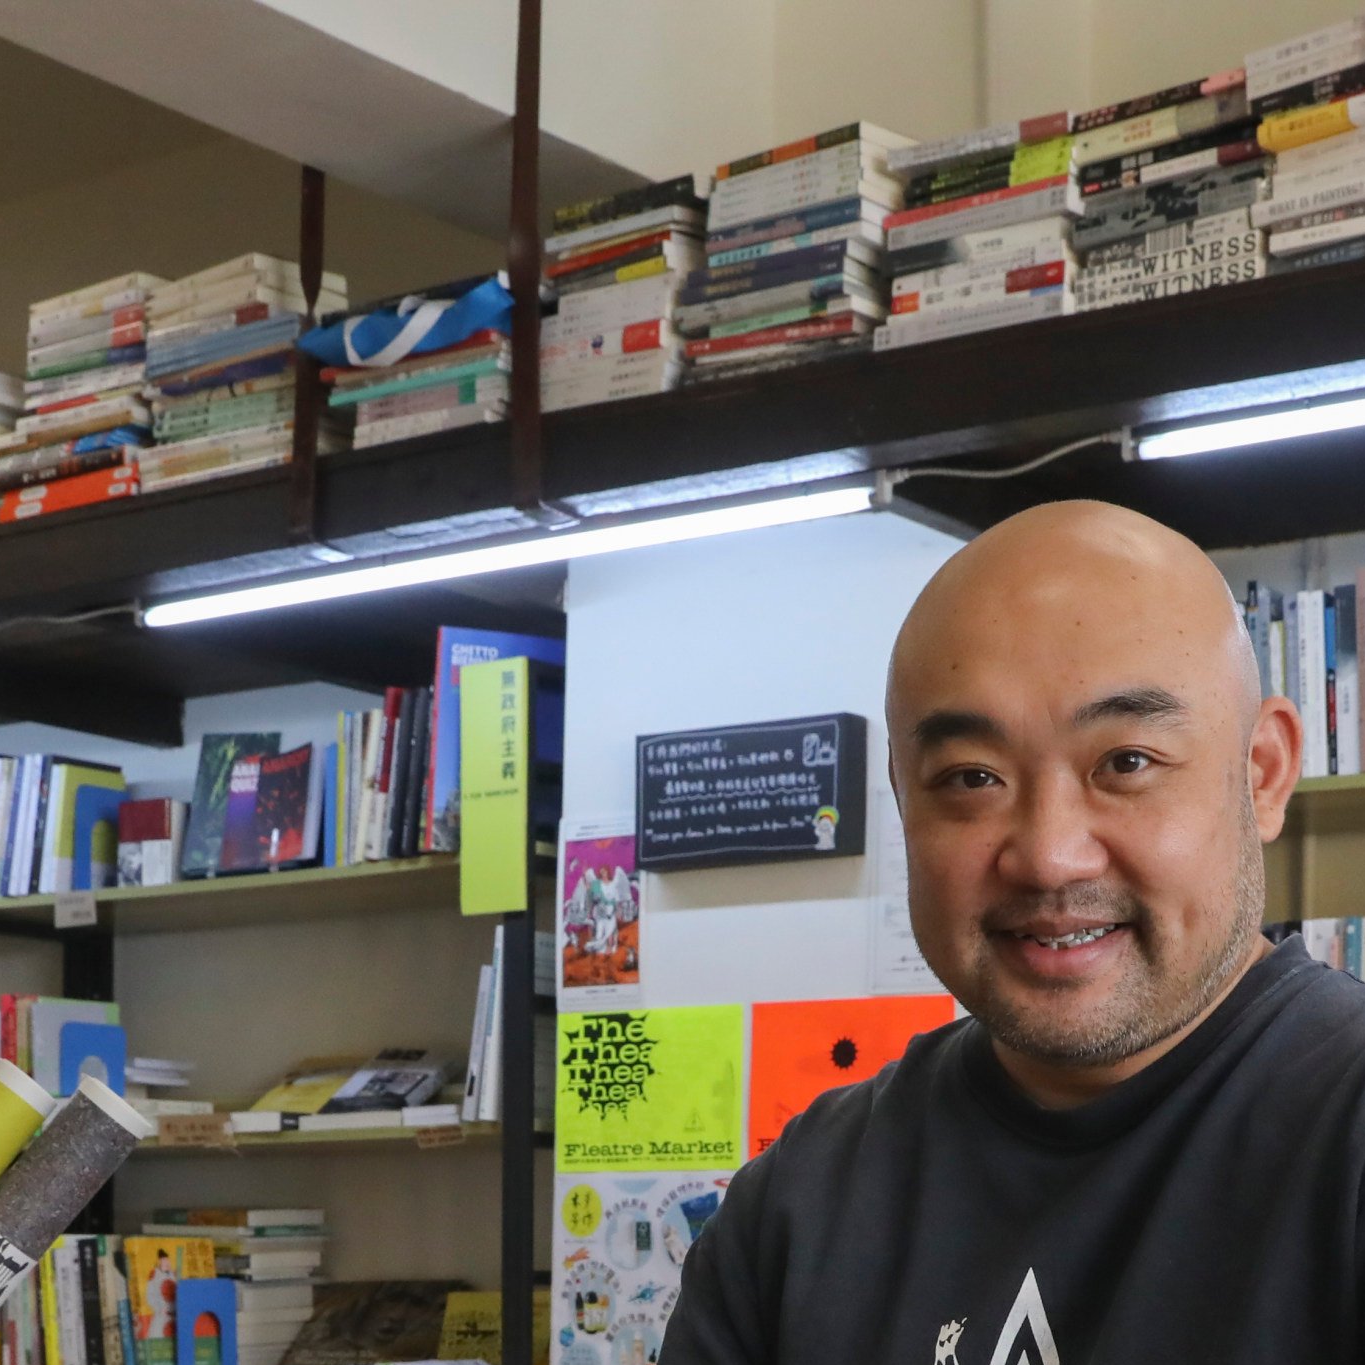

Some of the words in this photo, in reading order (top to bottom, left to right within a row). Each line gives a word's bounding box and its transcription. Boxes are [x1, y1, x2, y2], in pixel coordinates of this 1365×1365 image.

[1142, 231, 1259, 276] WITNESS
[1140, 258, 1259, 303] WITNESS
[564, 1141, 644, 1157] Fleatre
[650, 1139, 734, 1155] Market
